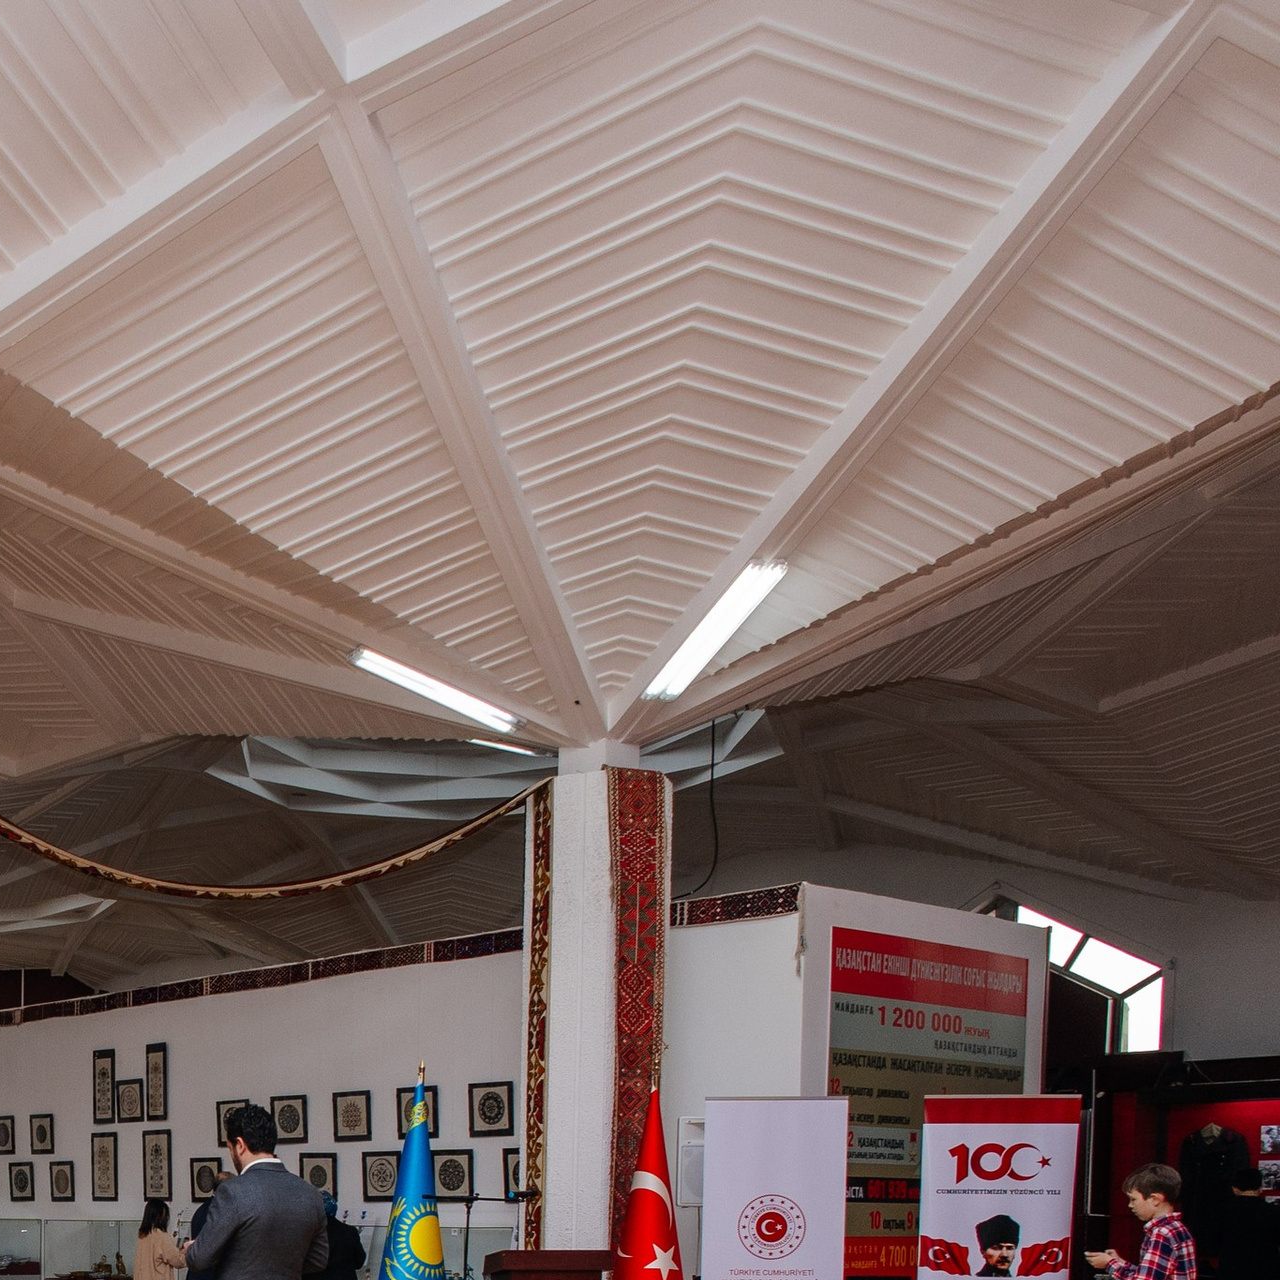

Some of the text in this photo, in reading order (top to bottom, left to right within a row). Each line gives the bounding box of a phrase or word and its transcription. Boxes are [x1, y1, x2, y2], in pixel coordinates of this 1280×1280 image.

[836, 947, 882, 974] ҚАЗАҚСТАН
[834, 1001, 874, 1016] МАЙДАНҒА
[877, 1005, 886, 1026] 1
[892, 1006, 925, 1030] 200
[931, 1012, 962, 1034] 000
[832, 1052, 887, 1071] ҚАЗАҚСТАНДА
[830, 1077, 841, 1095] 12
[1010, 1188, 1044, 1196] YÜZÜNCÜ
[870, 1210, 881, 1230] 10
[729, 1268, 814, 1276] TÜRKİYE CUMHURİYETİ
